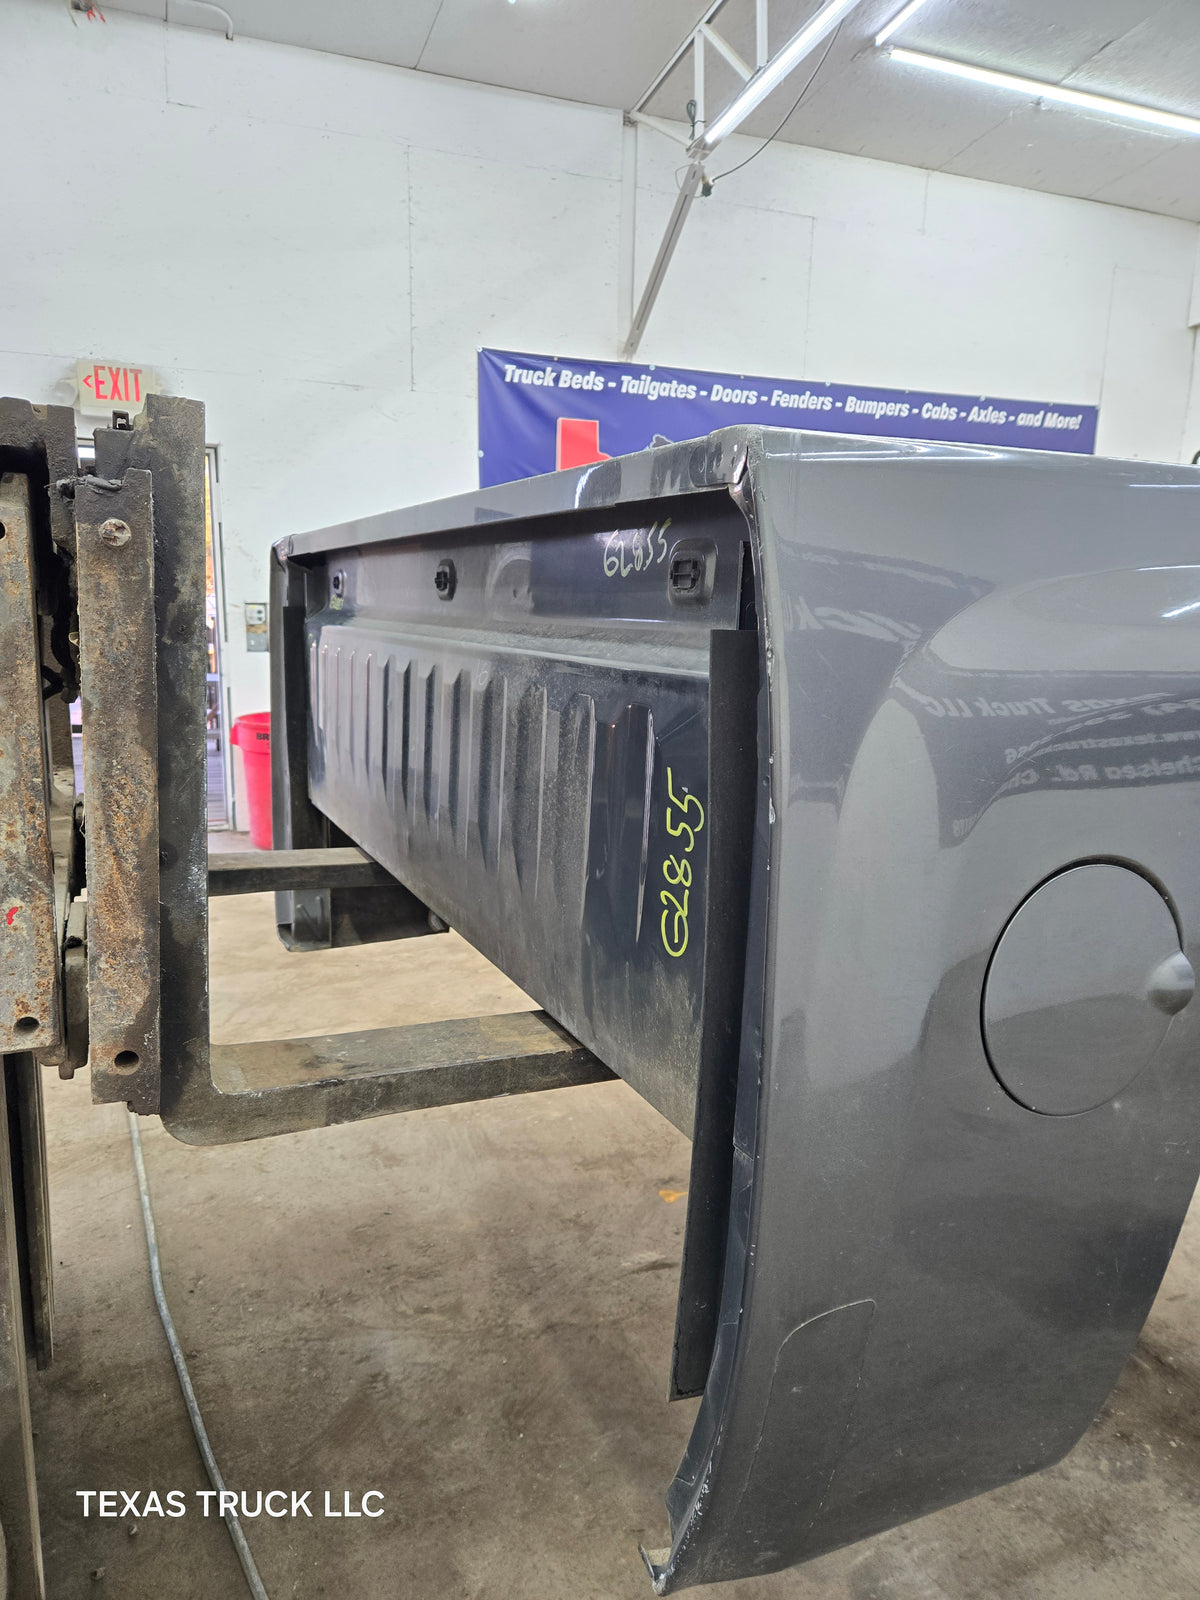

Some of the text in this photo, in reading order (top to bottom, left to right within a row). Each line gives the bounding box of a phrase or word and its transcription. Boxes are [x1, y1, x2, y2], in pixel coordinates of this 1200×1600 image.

[93, 365, 143, 402] EXIT
[504, 364, 555, 387] Truck
[558, 370, 604, 391] Beds
[621, 375, 697, 400] Tailgates
[711, 384, 757, 405] Doors
[770, 390, 833, 411] Fenders
[845, 396, 910, 419] Bumpers
[921, 402, 957, 421] Cabs
[967, 406, 1007, 425] Axles
[1016, 410, 1042, 427] and
[1044, 412, 1083, 430] More!
[660, 767, 705, 957] G2855
